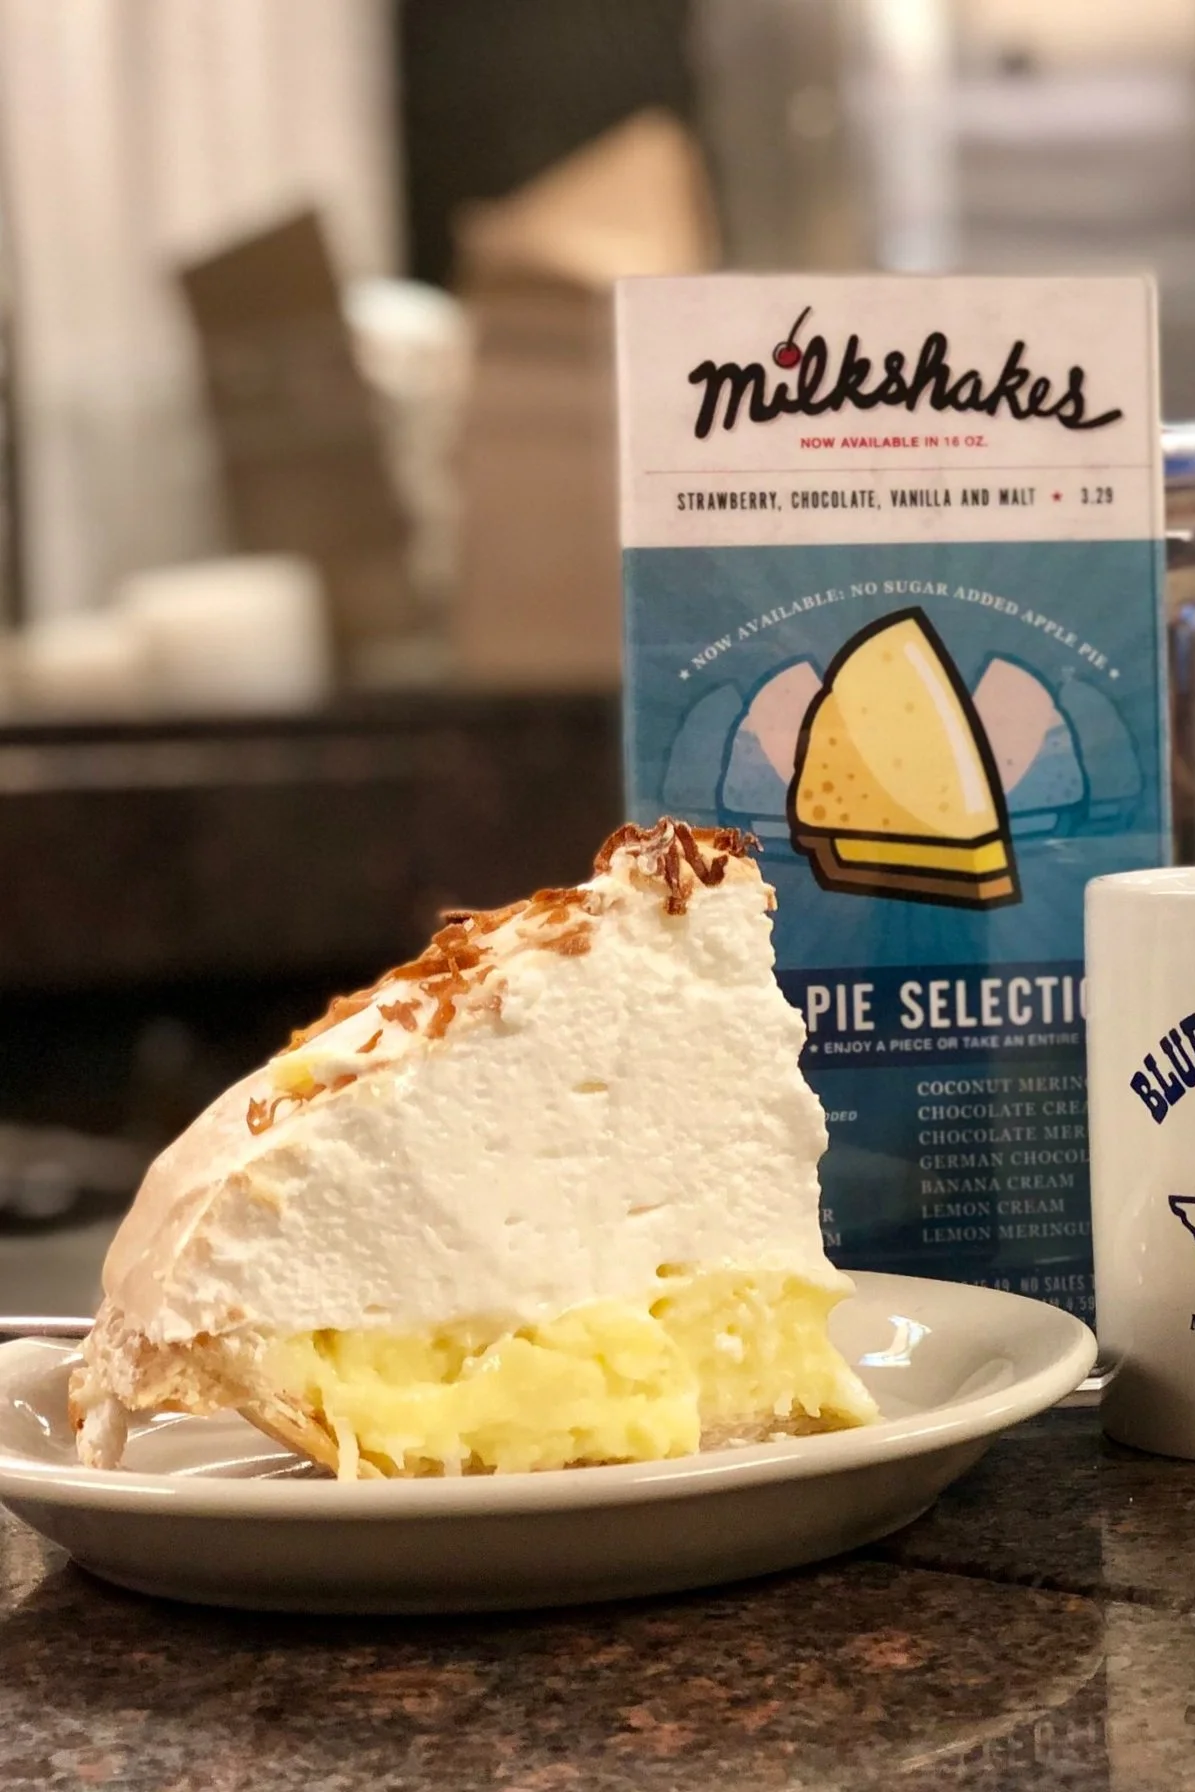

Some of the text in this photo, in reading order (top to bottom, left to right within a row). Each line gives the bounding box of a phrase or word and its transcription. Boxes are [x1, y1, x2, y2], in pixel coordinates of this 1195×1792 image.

[800, 436, 988, 450] NOW AVAILABLE IN 16 OZ.
[677, 486, 1113, 512] STRAWBERRY, CHOCOLATE, VANILLA AND MALT 3.29
[690, 580, 1108, 670] NOW AVAILABLE: NO SUGAR ADDED APPLE PIE
[806, 976, 1086, 1032] PIE SELECTI
[824, 1033, 1080, 1054] ENJOY A PIECE OR TAKE AN ENTIRE
[917, 1076, 1087, 1097] COCONUT MERIN
[917, 1102, 1036, 1121] CHOCOLATE
[918, 1126, 1037, 1145] CHOCOLATE
[919, 1152, 1003, 1171] GERMAN
[921, 1173, 1075, 1195] BANANA CREAM
[921, 1198, 1065, 1219] LEMON CREAM
[922, 1226, 992, 1244] LEMON
[1020, 1277, 1039, 1292] NO
[1044, 1274, 1085, 1292] SALES
